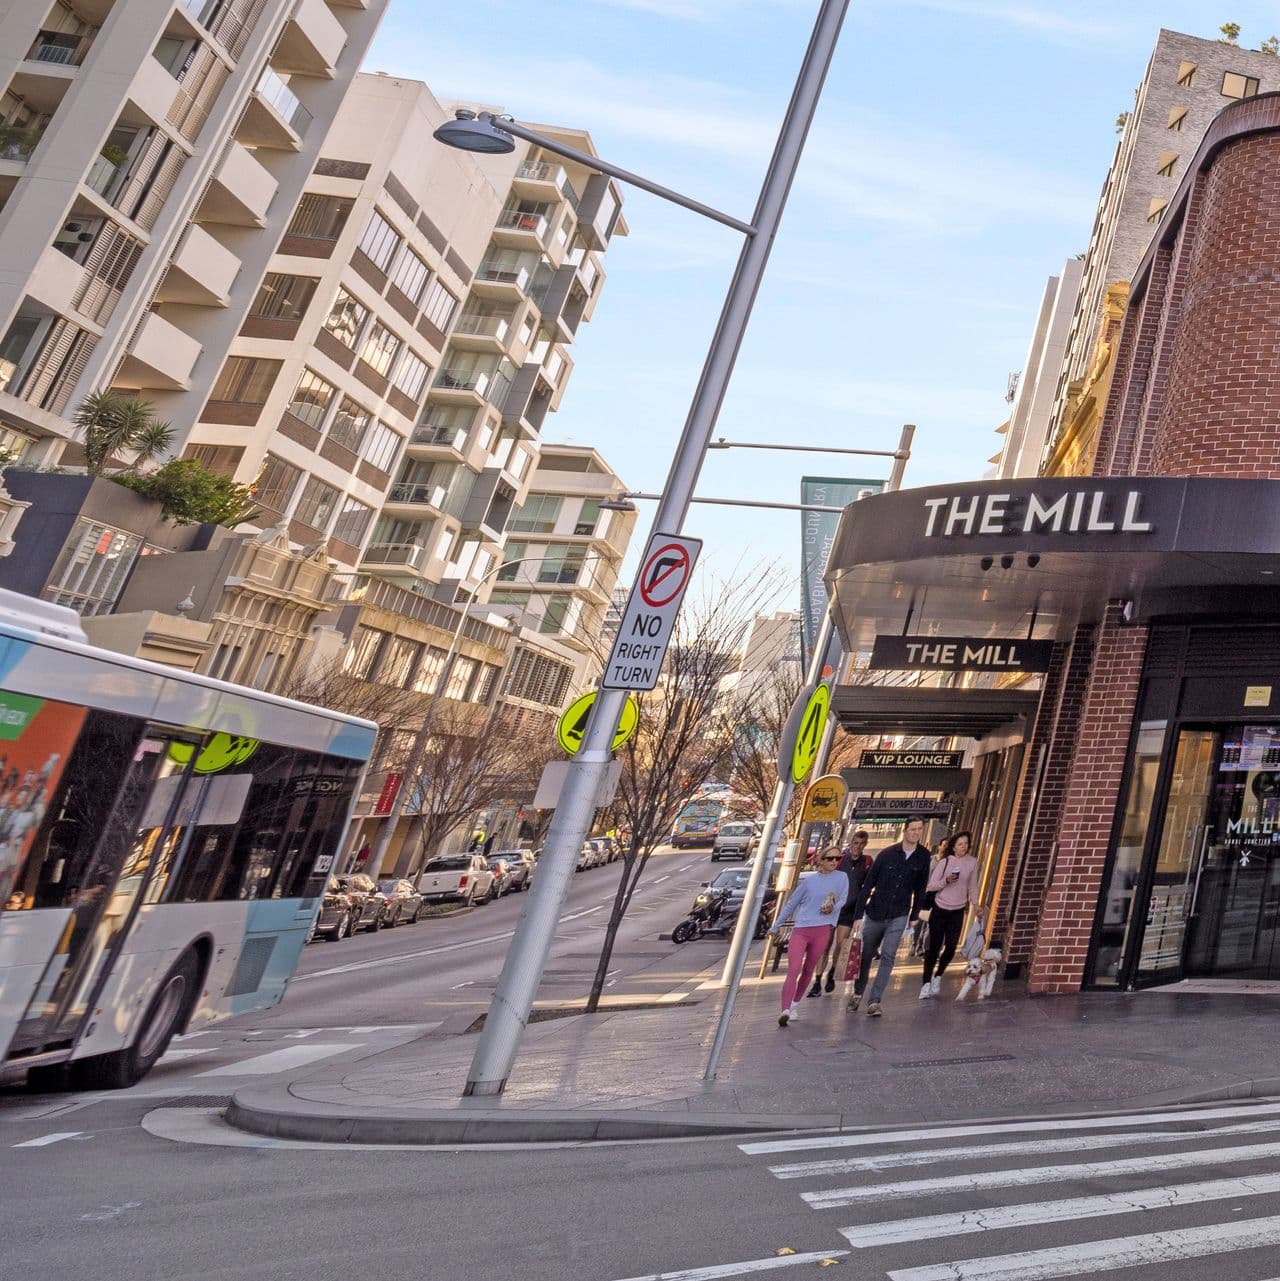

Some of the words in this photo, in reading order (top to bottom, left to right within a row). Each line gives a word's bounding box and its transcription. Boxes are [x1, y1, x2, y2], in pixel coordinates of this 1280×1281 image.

[924, 493, 1010, 537] THE
[1023, 491, 1151, 532] MILL
[631, 613, 663, 638] NO
[616, 643, 662, 661] RIGHT
[906, 643, 958, 665] THE
[962, 645, 1022, 666] MILL
[614, 665, 653, 683] TURN
[873, 755, 896, 765] VIP
[897, 755, 951, 765] LOUNGE
[889, 800, 935, 809] COMPUTERS
[1226, 817, 1273, 834] MILL
